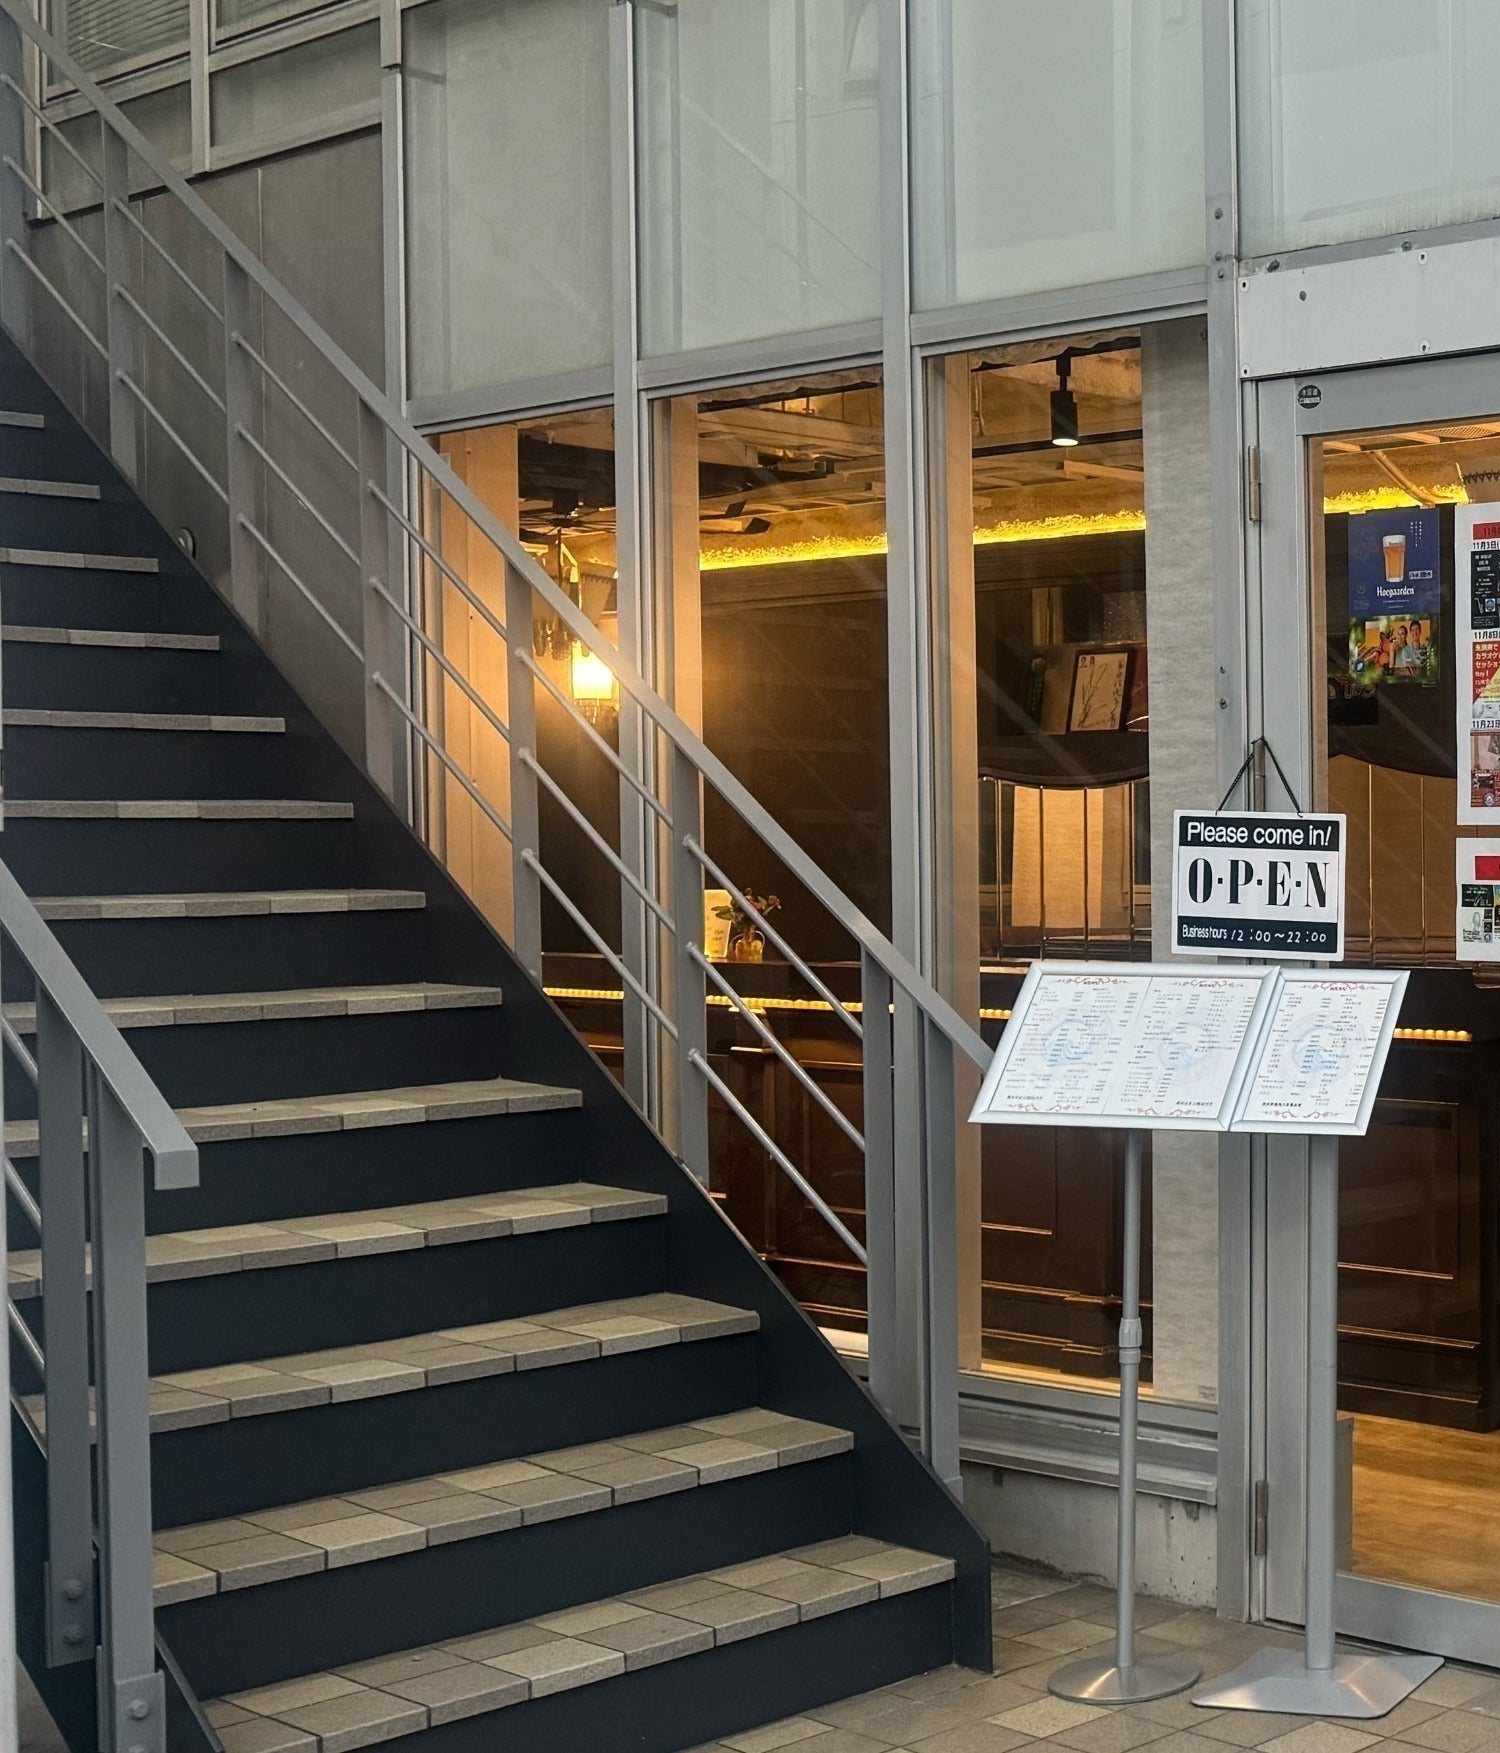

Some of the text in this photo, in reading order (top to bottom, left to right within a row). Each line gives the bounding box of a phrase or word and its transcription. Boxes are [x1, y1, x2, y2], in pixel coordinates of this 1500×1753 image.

[1376, 586, 1415, 597] Hoegaarden
[1187, 821, 1332, 846] Please come in!
[1182, 925, 1209, 938] Business
[1209, 927, 1227, 939] hours
